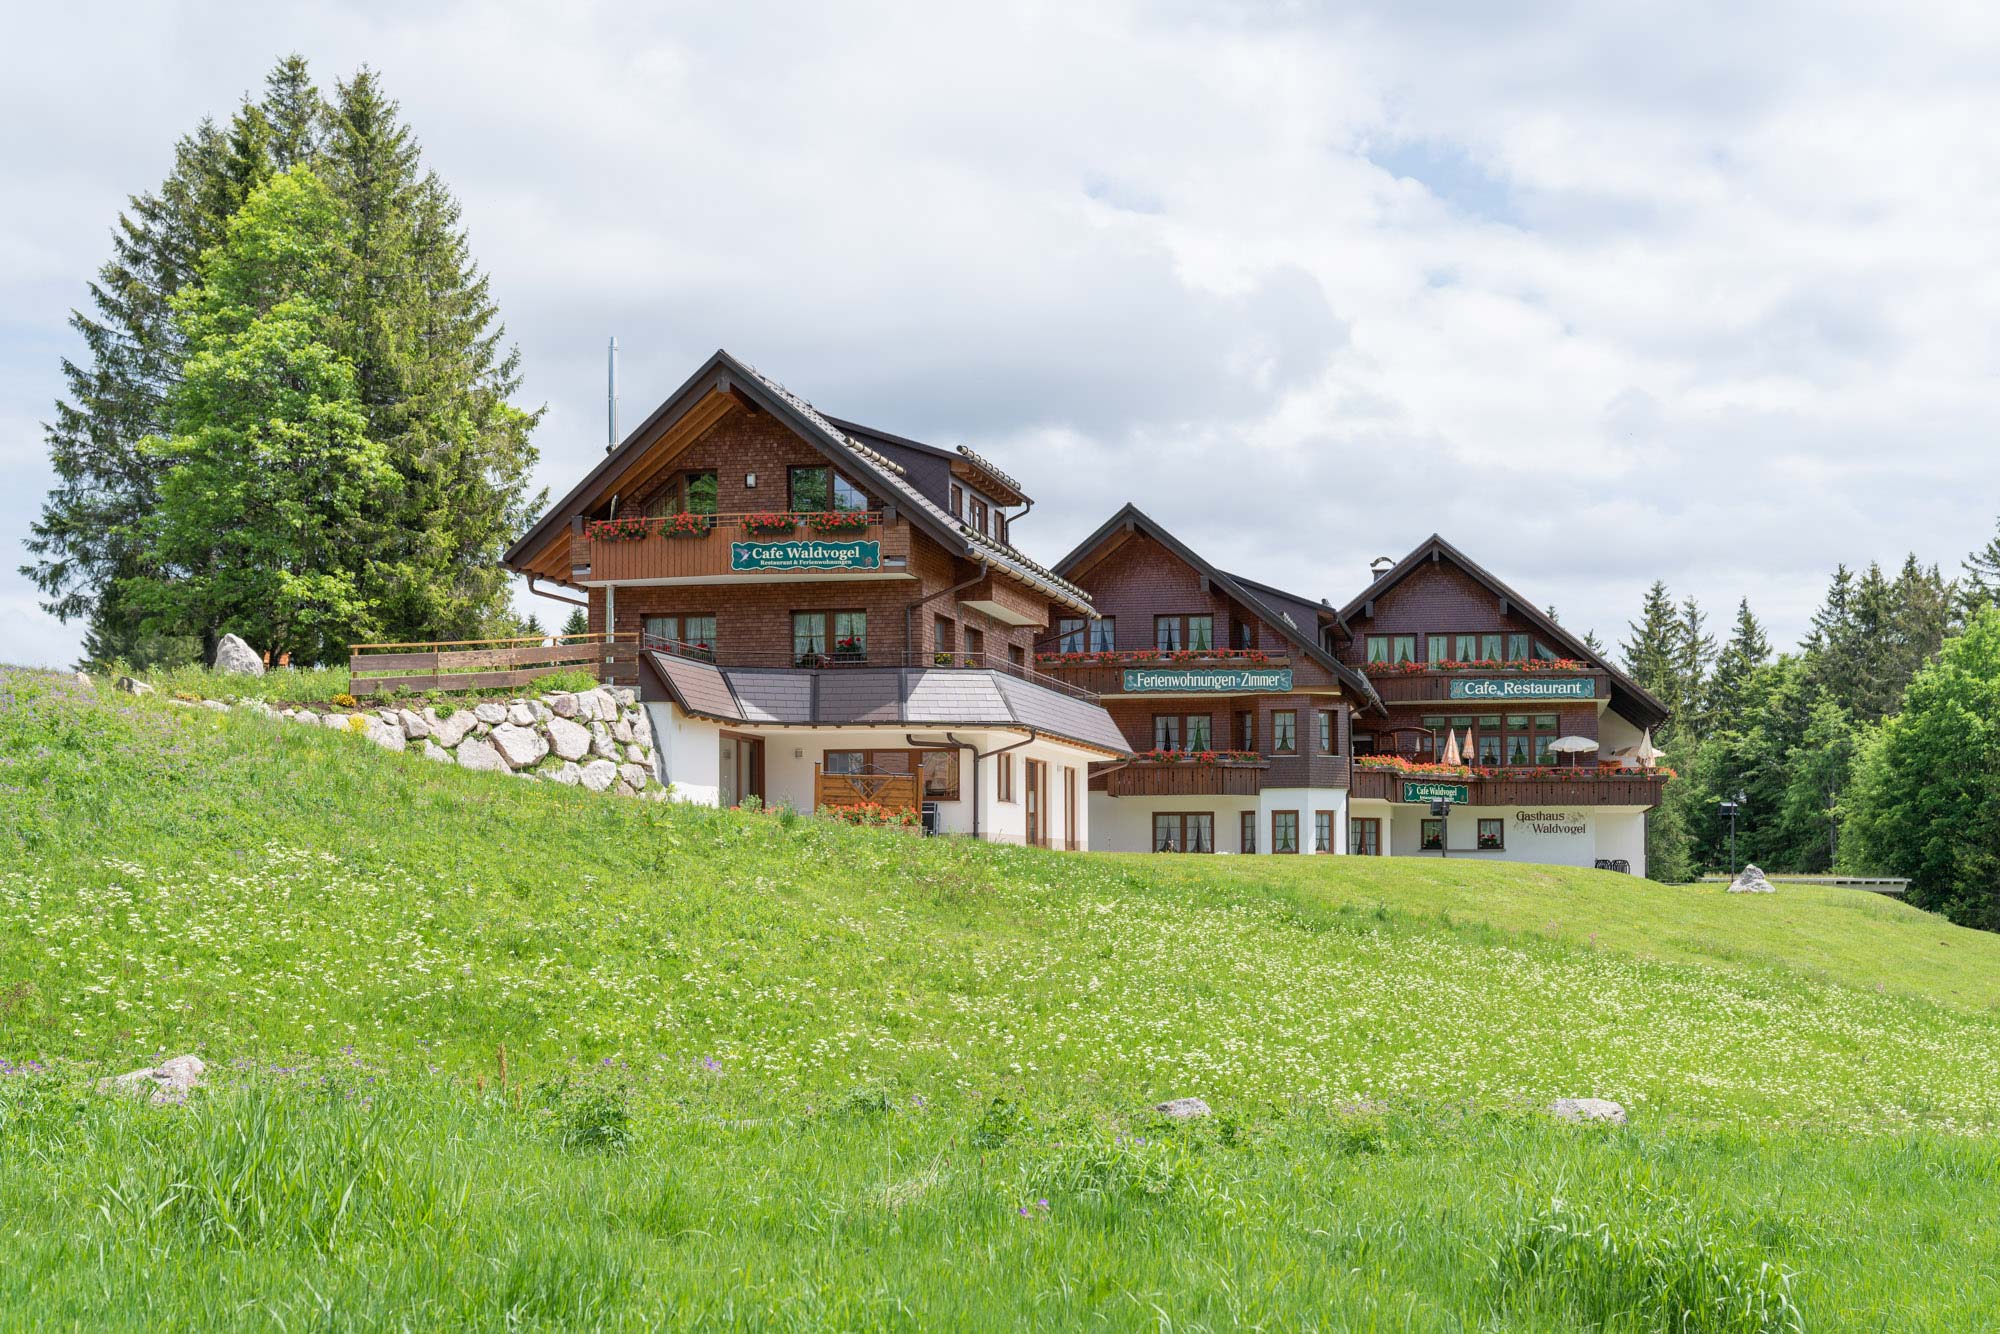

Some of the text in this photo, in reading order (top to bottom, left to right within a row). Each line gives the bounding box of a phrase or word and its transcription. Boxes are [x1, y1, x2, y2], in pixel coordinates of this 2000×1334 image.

[752, 546, 860, 560] Cafe Waldvogel
[1137, 672, 1279, 689] Ferienwohnungen Zimmer
[1464, 681, 1581, 695] Cafe Restaurant
[1416, 785, 1457, 798] Cafe Waldvogel
[1516, 811, 1565, 823] Gasthaus
[1532, 823, 1586, 835] Waldvogel
